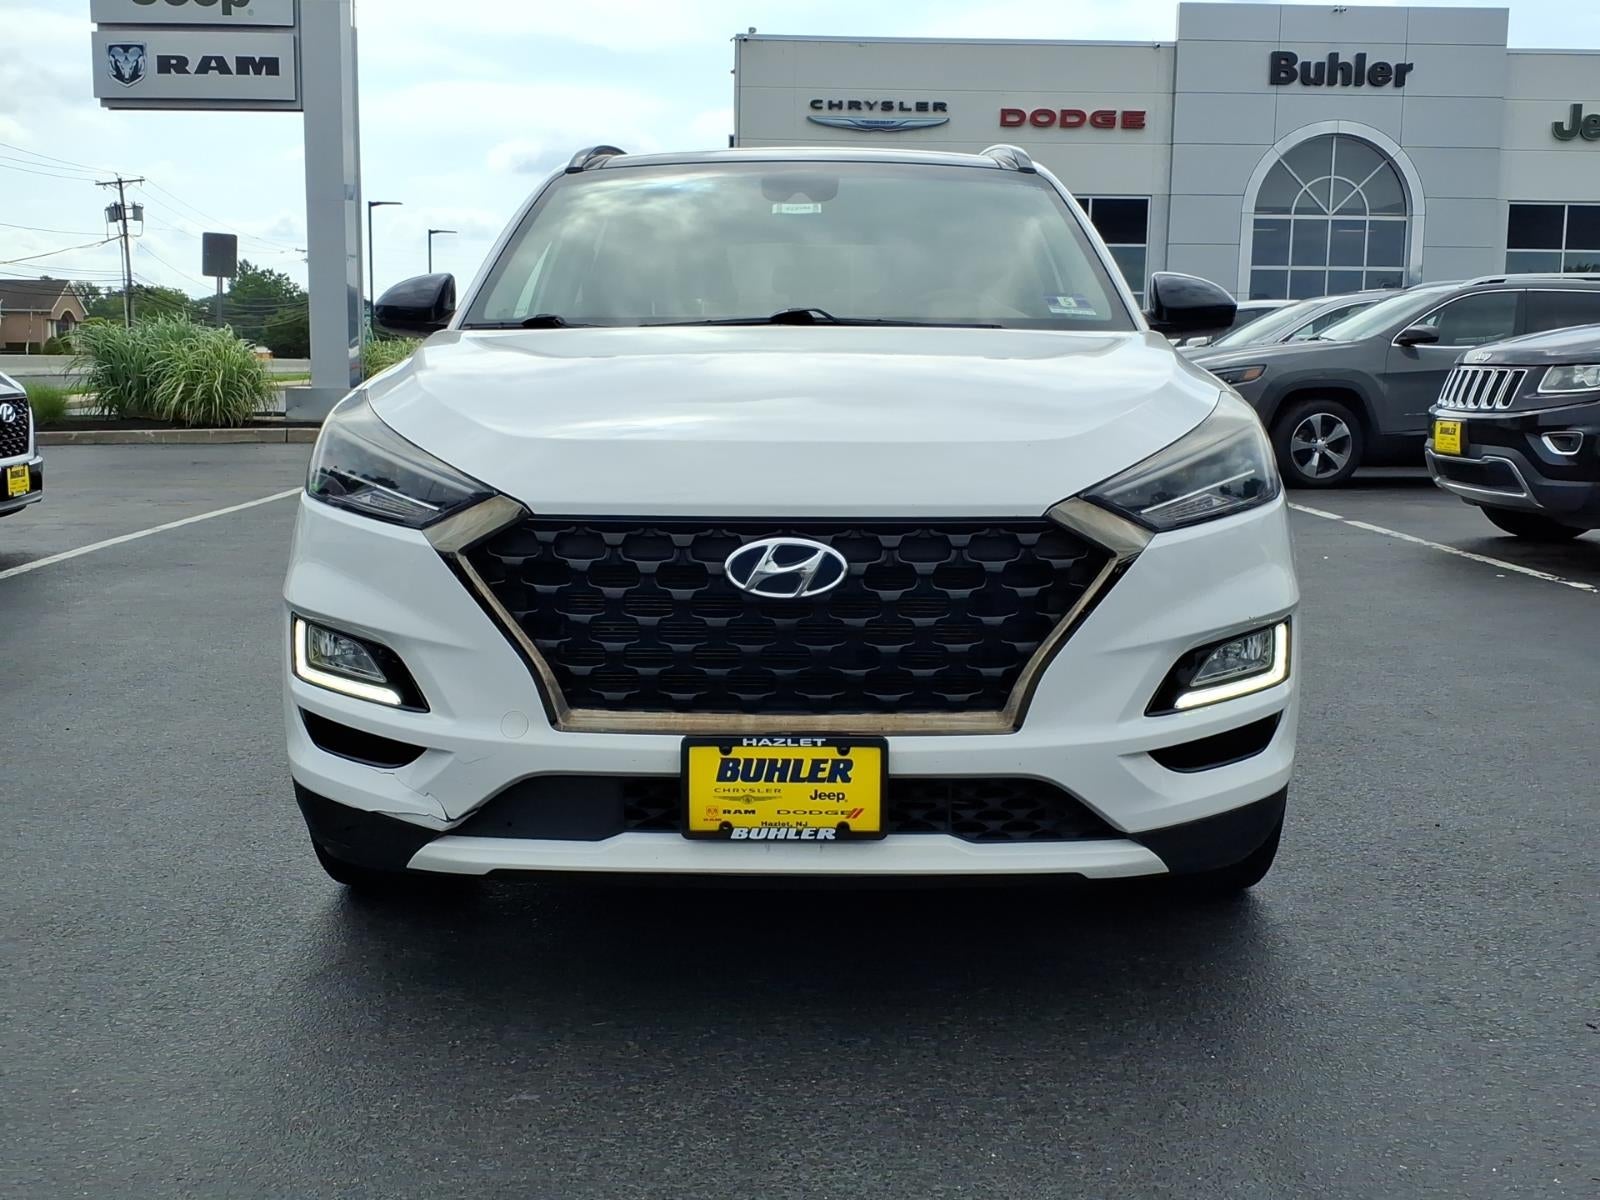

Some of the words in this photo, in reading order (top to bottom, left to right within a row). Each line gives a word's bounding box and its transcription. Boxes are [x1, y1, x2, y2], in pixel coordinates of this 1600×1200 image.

[157, 55, 280, 77] RAM
[1270, 51, 1414, 87] Buhler
[810, 99, 948, 113] CHRYSLER
[1000, 108, 1146, 129] DODGE
[742, 738, 826, 746] HAZLET
[716, 757, 854, 783] BUHLER
[809, 790, 846, 803] Jeep
[730, 827, 836, 840] BUHLER
